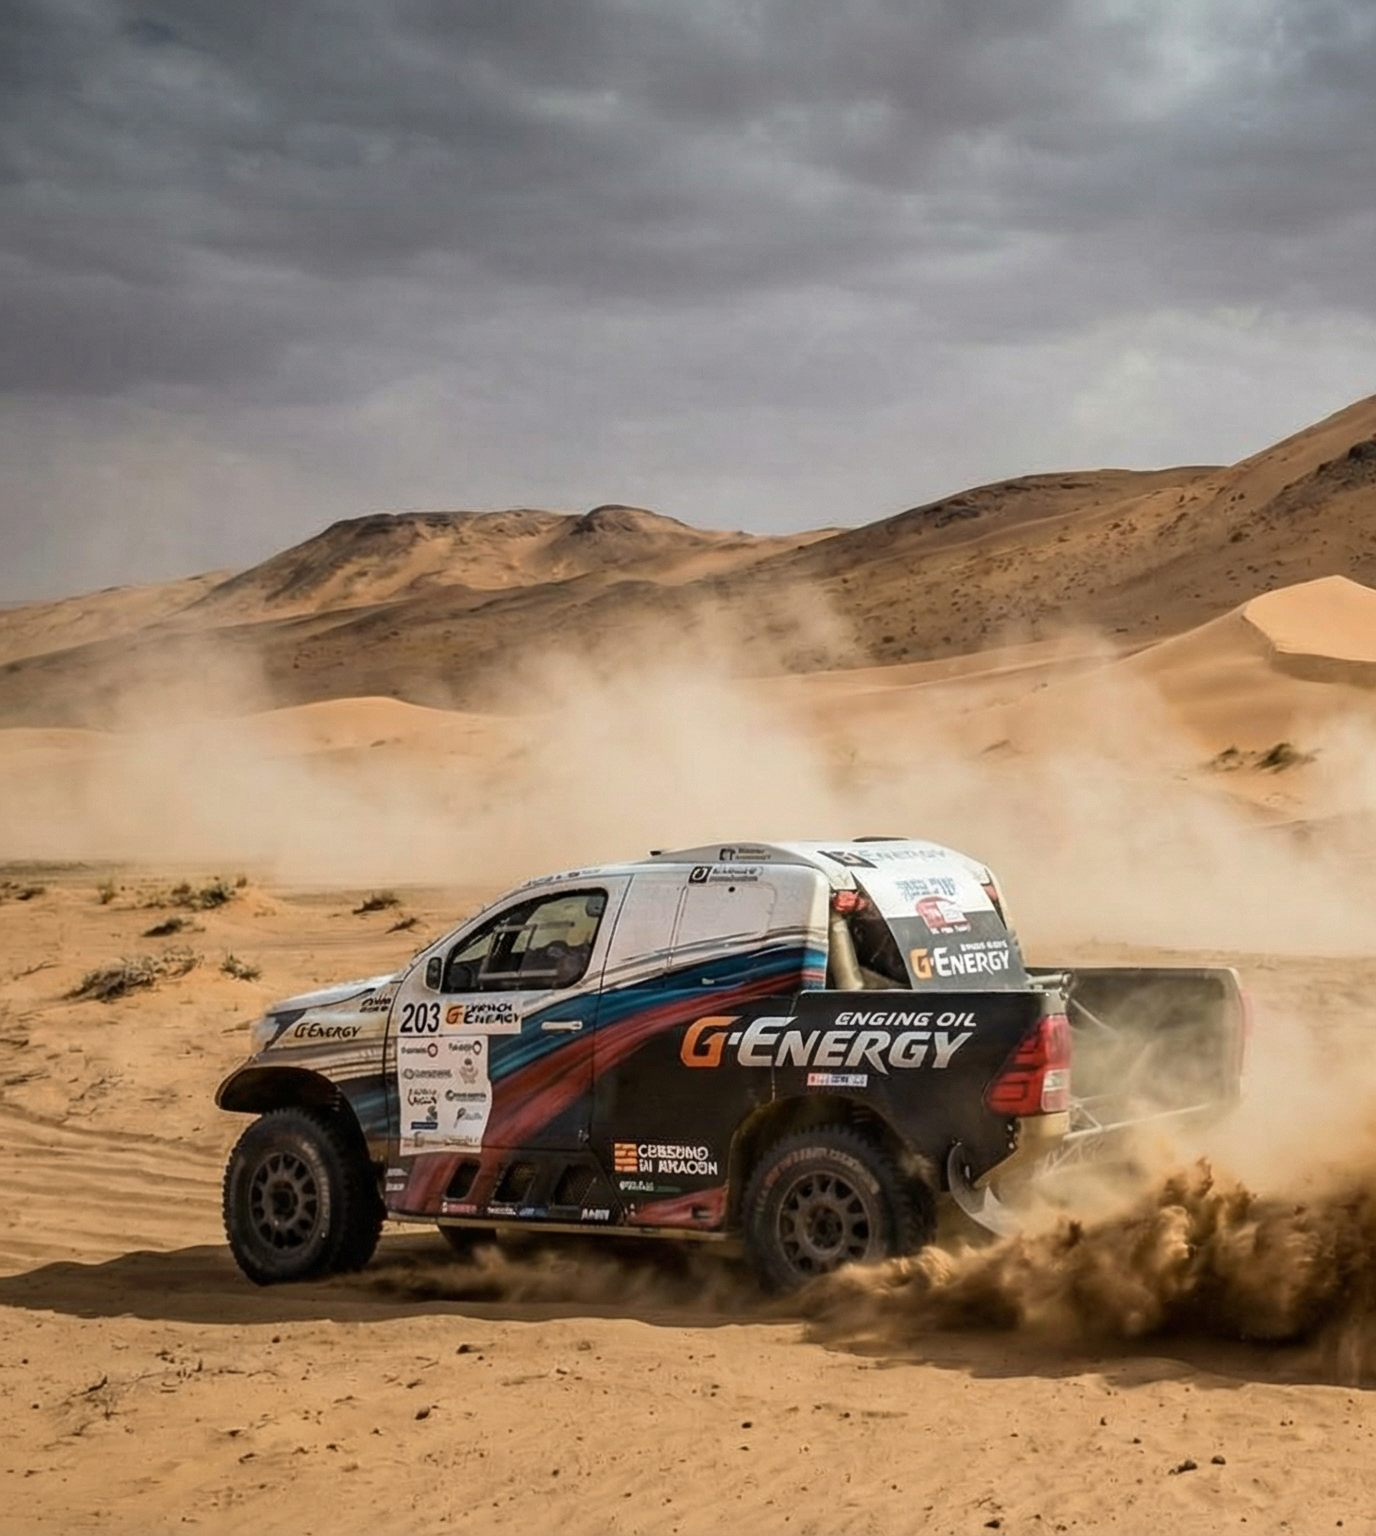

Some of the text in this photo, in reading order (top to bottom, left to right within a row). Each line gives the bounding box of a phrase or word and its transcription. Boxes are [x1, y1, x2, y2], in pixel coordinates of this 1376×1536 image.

[400, 1003, 440, 1033] 203
[936, 1012, 977, 1027] OIL
[680, 1015, 974, 1075] G-ENERGY
